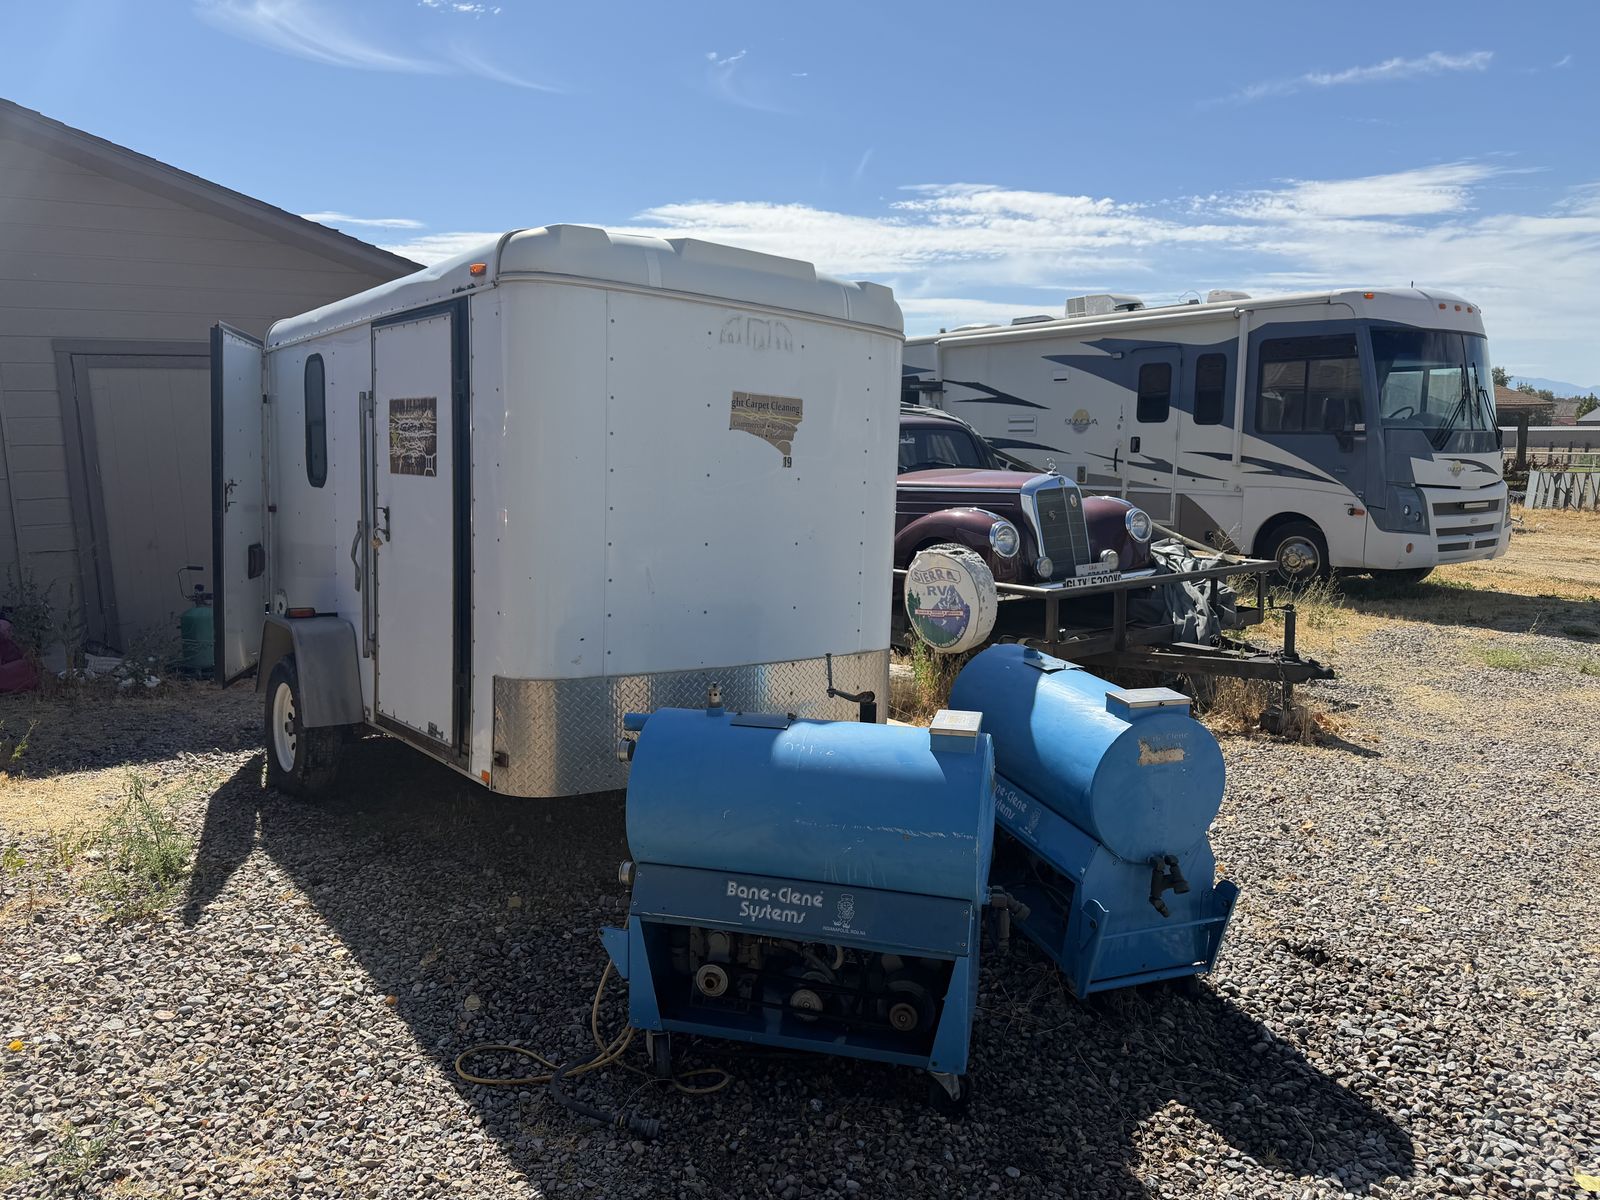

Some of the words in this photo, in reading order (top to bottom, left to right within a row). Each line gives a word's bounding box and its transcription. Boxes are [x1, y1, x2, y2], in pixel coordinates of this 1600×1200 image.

[731, 397, 745, 409] ght
[745, 398, 769, 411] Carpet
[770, 401, 800, 416] Cleaning
[913, 568, 957, 583] SIERRA
[927, 585, 948, 597] RV
[995, 784, 1027, 813] ne-Clene
[727, 880, 823, 908] Bane-Clene
[739, 901, 806, 924] Systems
